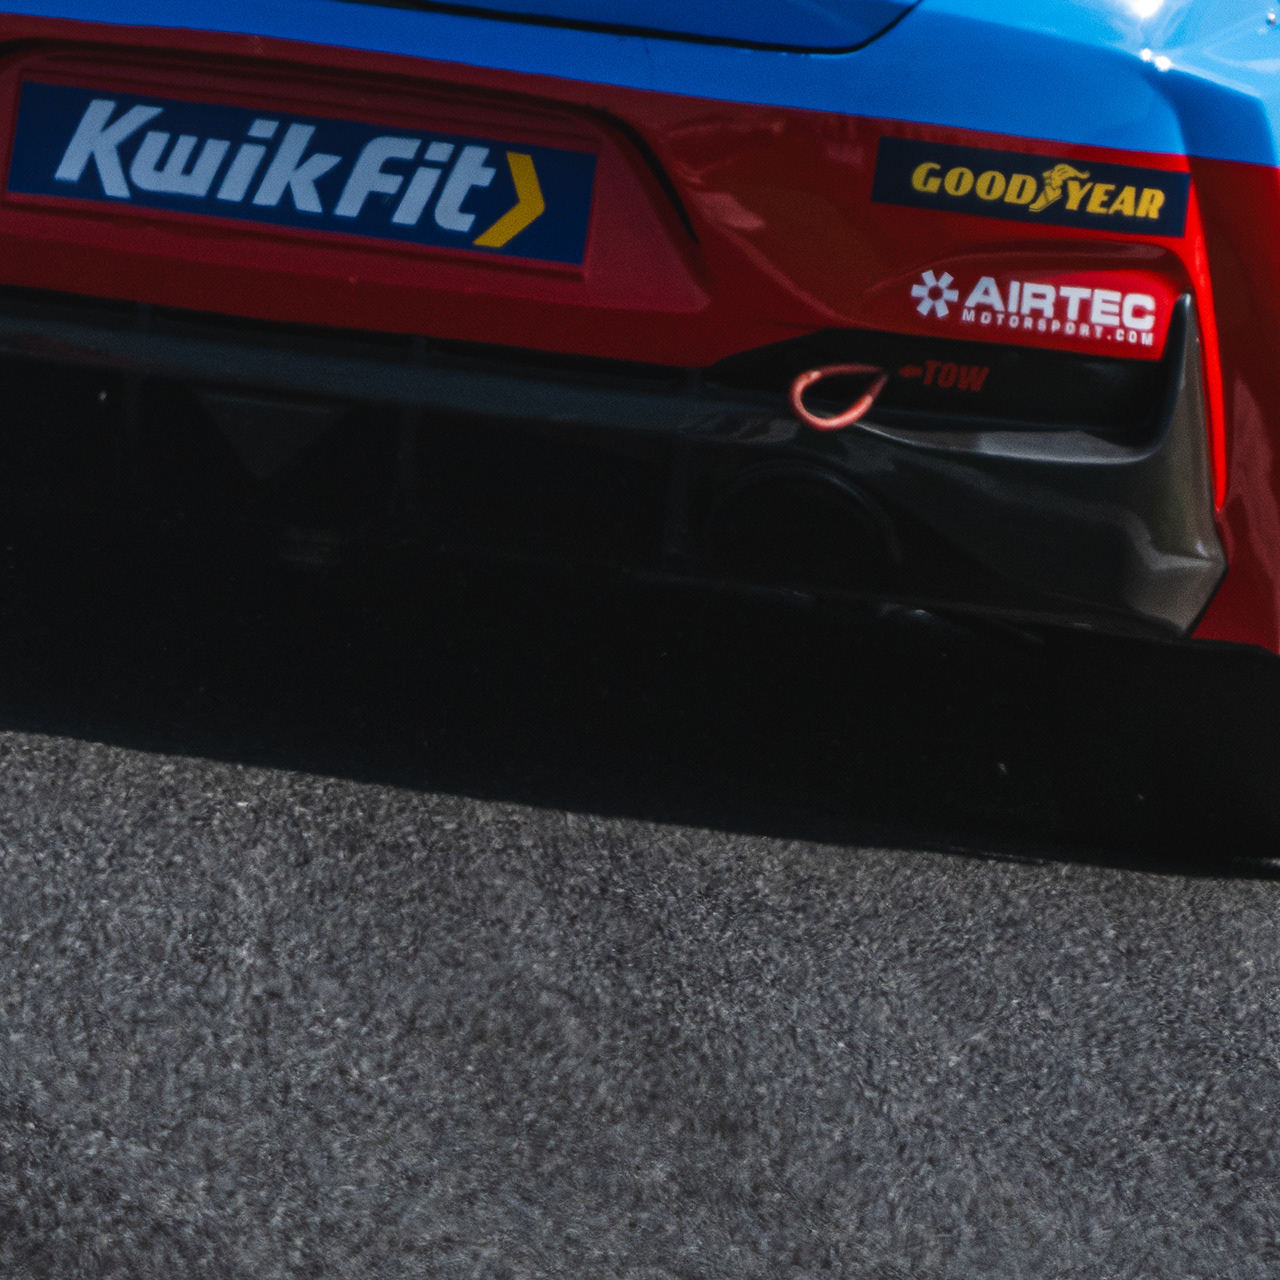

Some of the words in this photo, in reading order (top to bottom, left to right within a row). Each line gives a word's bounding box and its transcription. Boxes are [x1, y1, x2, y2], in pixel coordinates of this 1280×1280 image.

[910, 162, 1166, 220] GOODYEAR
[961, 307, 1155, 347] MOTORSPORT.COM
[963, 276, 1156, 331] AIRTEC
[922, 360, 990, 393] TOW
